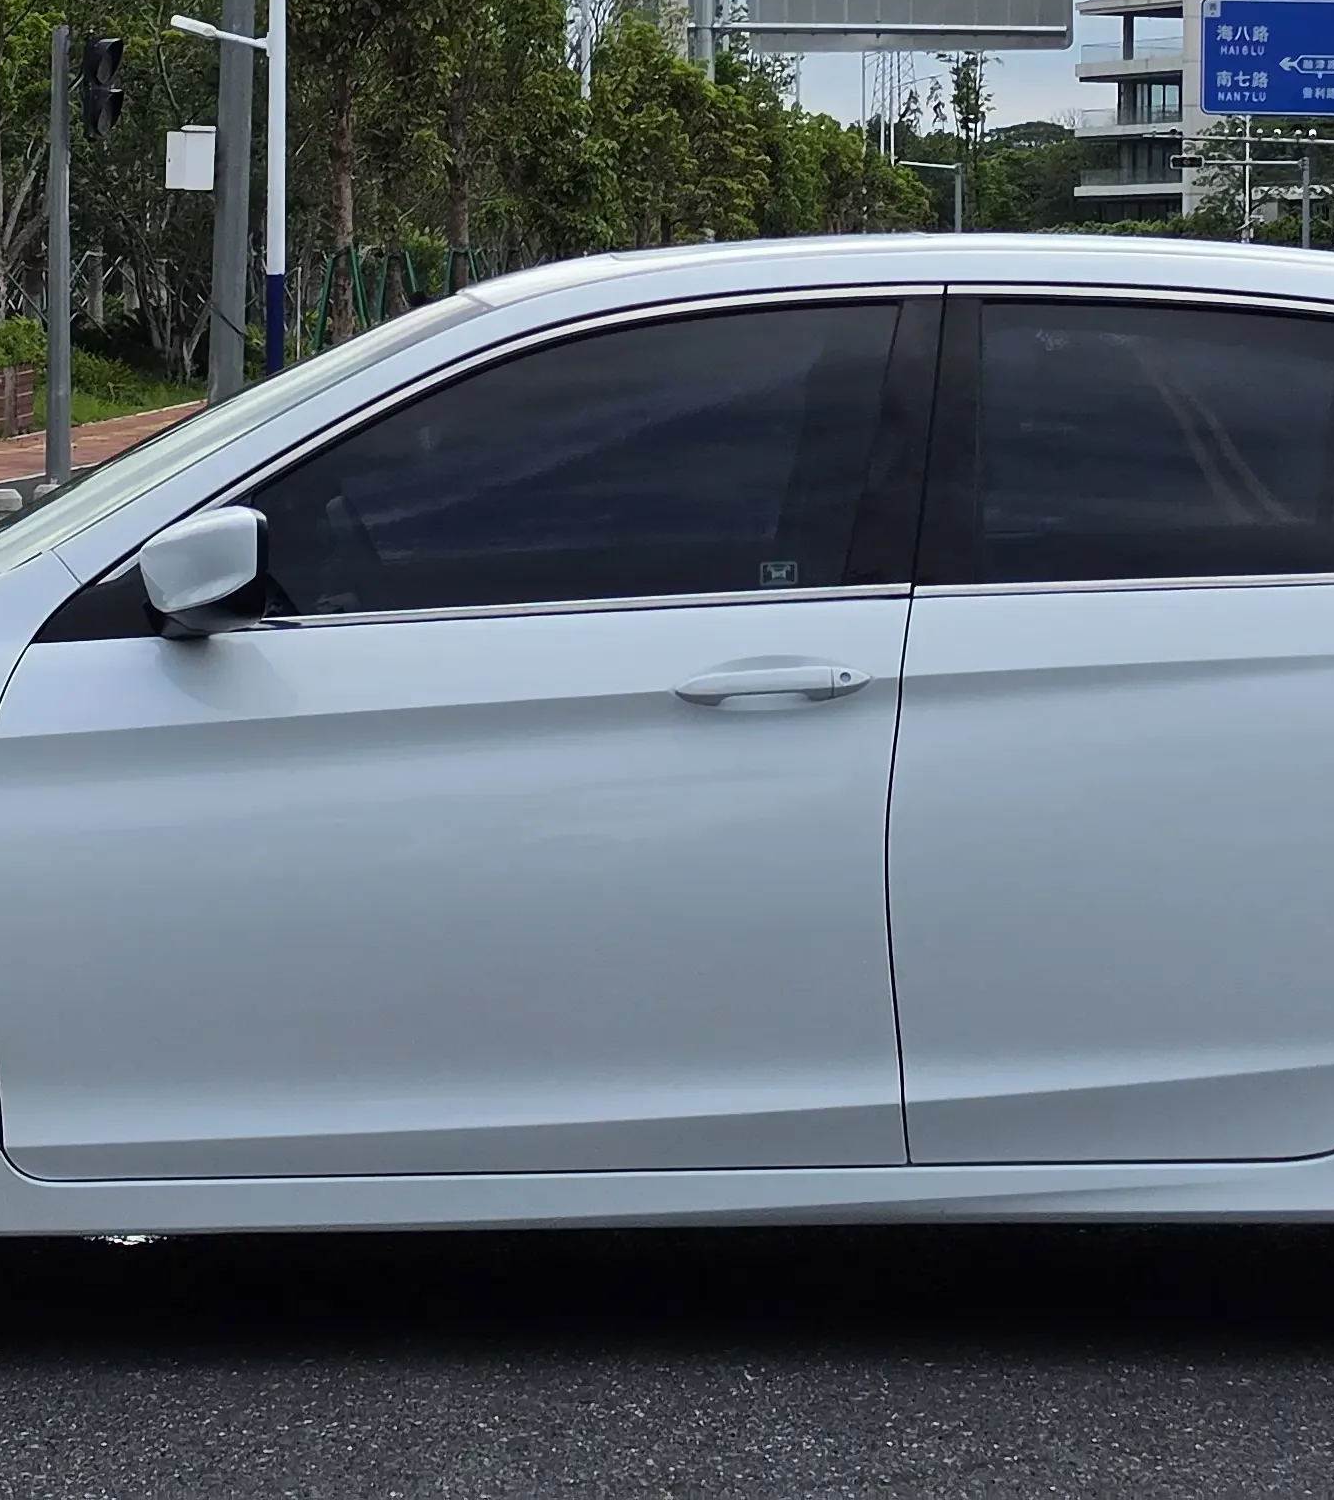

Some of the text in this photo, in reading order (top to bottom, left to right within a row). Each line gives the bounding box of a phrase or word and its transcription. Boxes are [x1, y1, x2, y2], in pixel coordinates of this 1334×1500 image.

[1216, 25, 1269, 42] 海八路
[1250, 45, 1265, 56] LU
[1216, 70, 1269, 88] 南七路
[1217, 91, 1241, 102] NAN
[1251, 91, 1267, 102] LU
